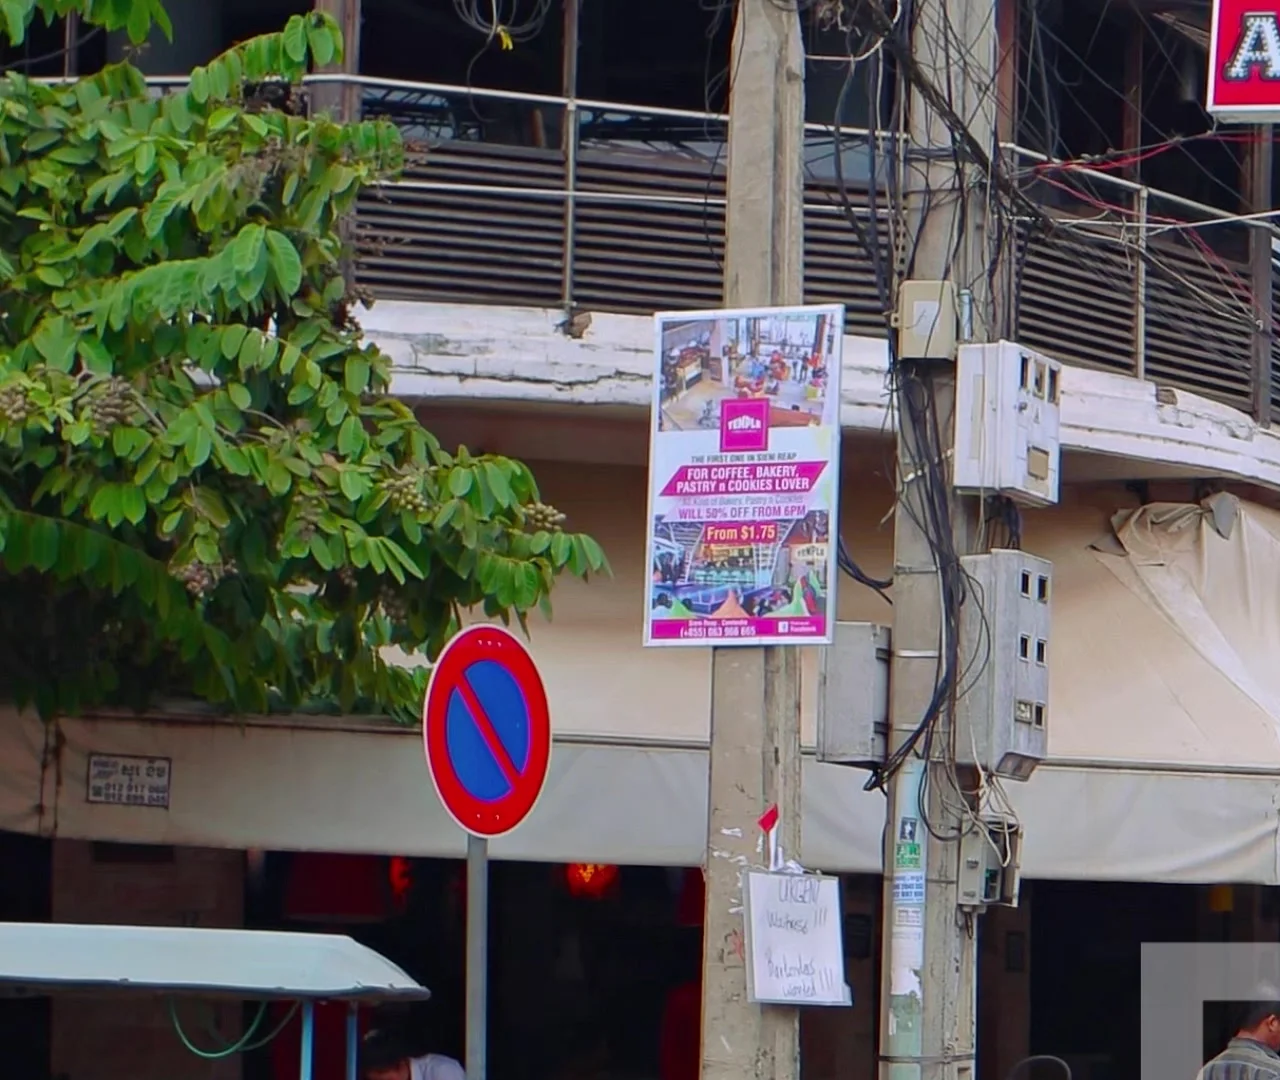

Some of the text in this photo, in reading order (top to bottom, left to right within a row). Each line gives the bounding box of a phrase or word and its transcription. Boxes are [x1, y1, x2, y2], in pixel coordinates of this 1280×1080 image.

[707, 455, 729, 463] FIRST
[730, 454, 745, 462] ONE
[777, 452, 797, 461] REAP
[687, 465, 800, 480] FOR COFFEE, BAKERY,
[676, 481, 716, 493] PASTRY
[727, 479, 773, 491] COOKIES
[775, 478, 810, 490] LOVER
[678, 504, 806, 519] WILL 50% OFF FROM 6PM
[706, 524, 776, 541] From $1.75
